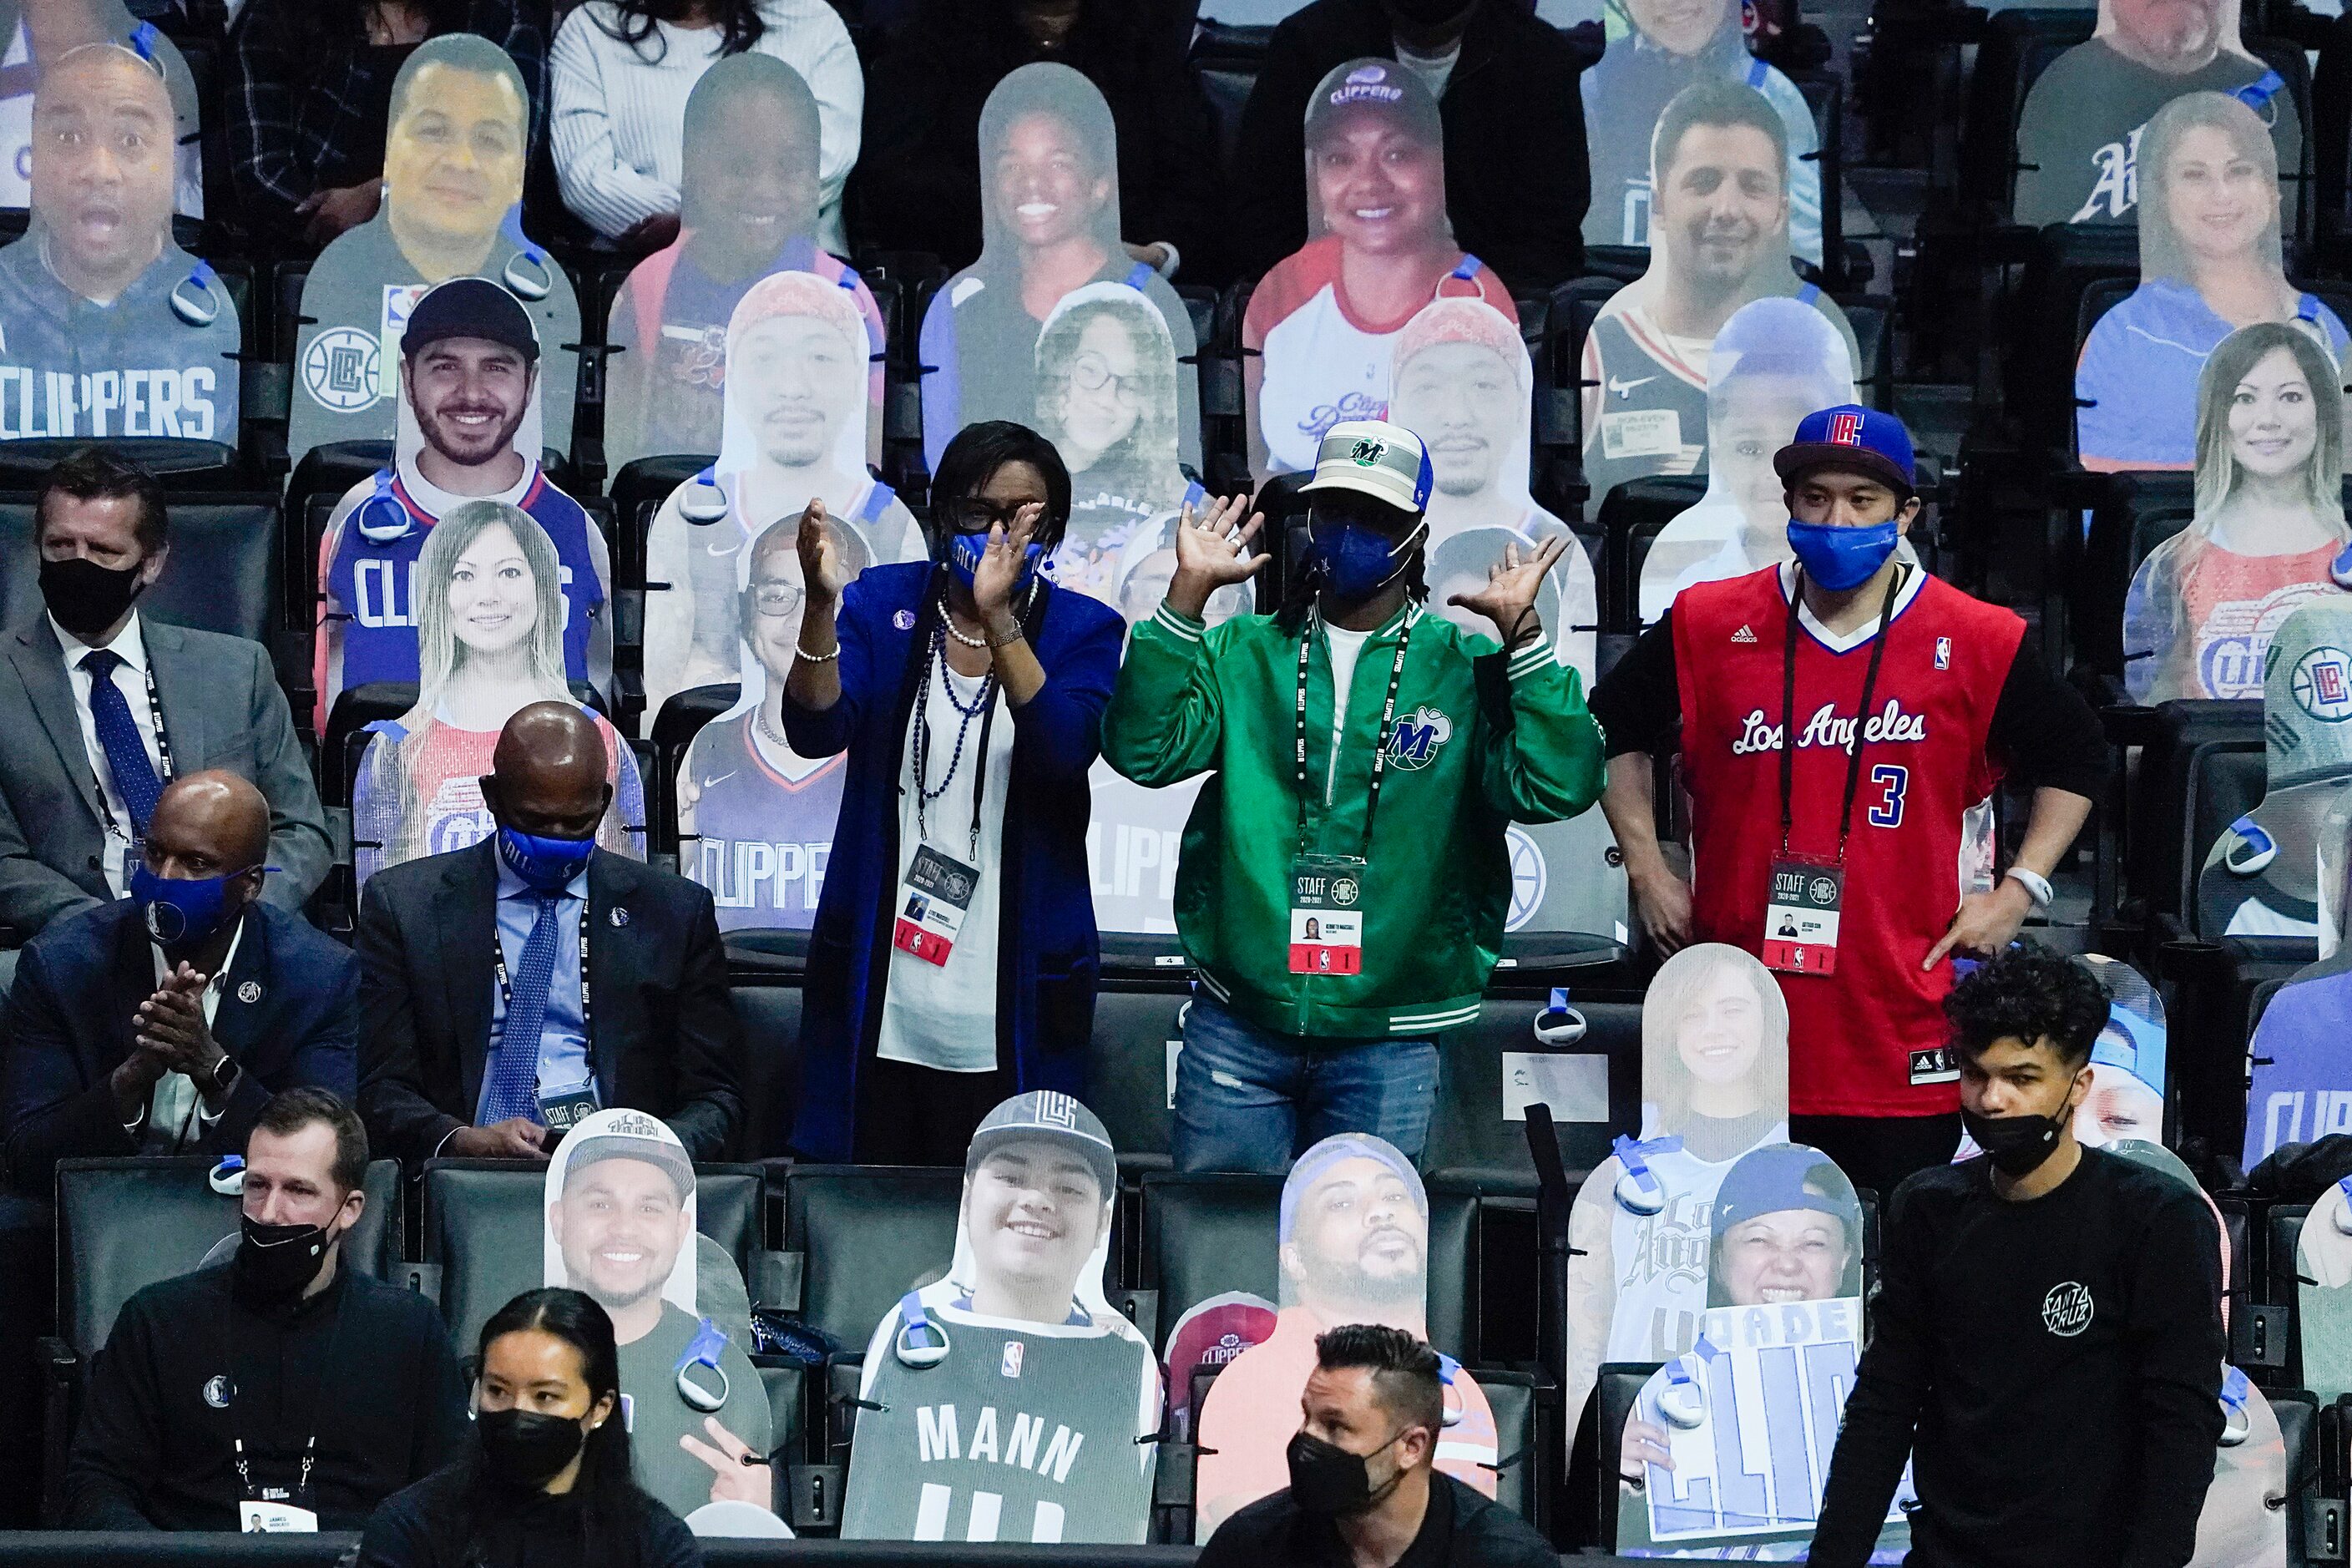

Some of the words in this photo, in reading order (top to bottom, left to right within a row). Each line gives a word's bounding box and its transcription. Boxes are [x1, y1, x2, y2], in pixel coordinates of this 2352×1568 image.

[0, 366, 216, 440] CLIPPERS
[1350, 442, 1384, 463] M
[1385, 721, 1440, 761] M
[1732, 709, 1783, 755] Los
[1868, 764, 1909, 828] 3
[701, 837, 833, 908] CLIPPE
[1297, 877, 1327, 895] STAFF
[1775, 873, 1805, 893] STAFF
[544, 1105, 571, 1125] STAFF
[2041, 1286, 2089, 1317] SANTA
[2048, 1302, 2090, 1333] CRUZ
[917, 1404, 1084, 1485] MANN
